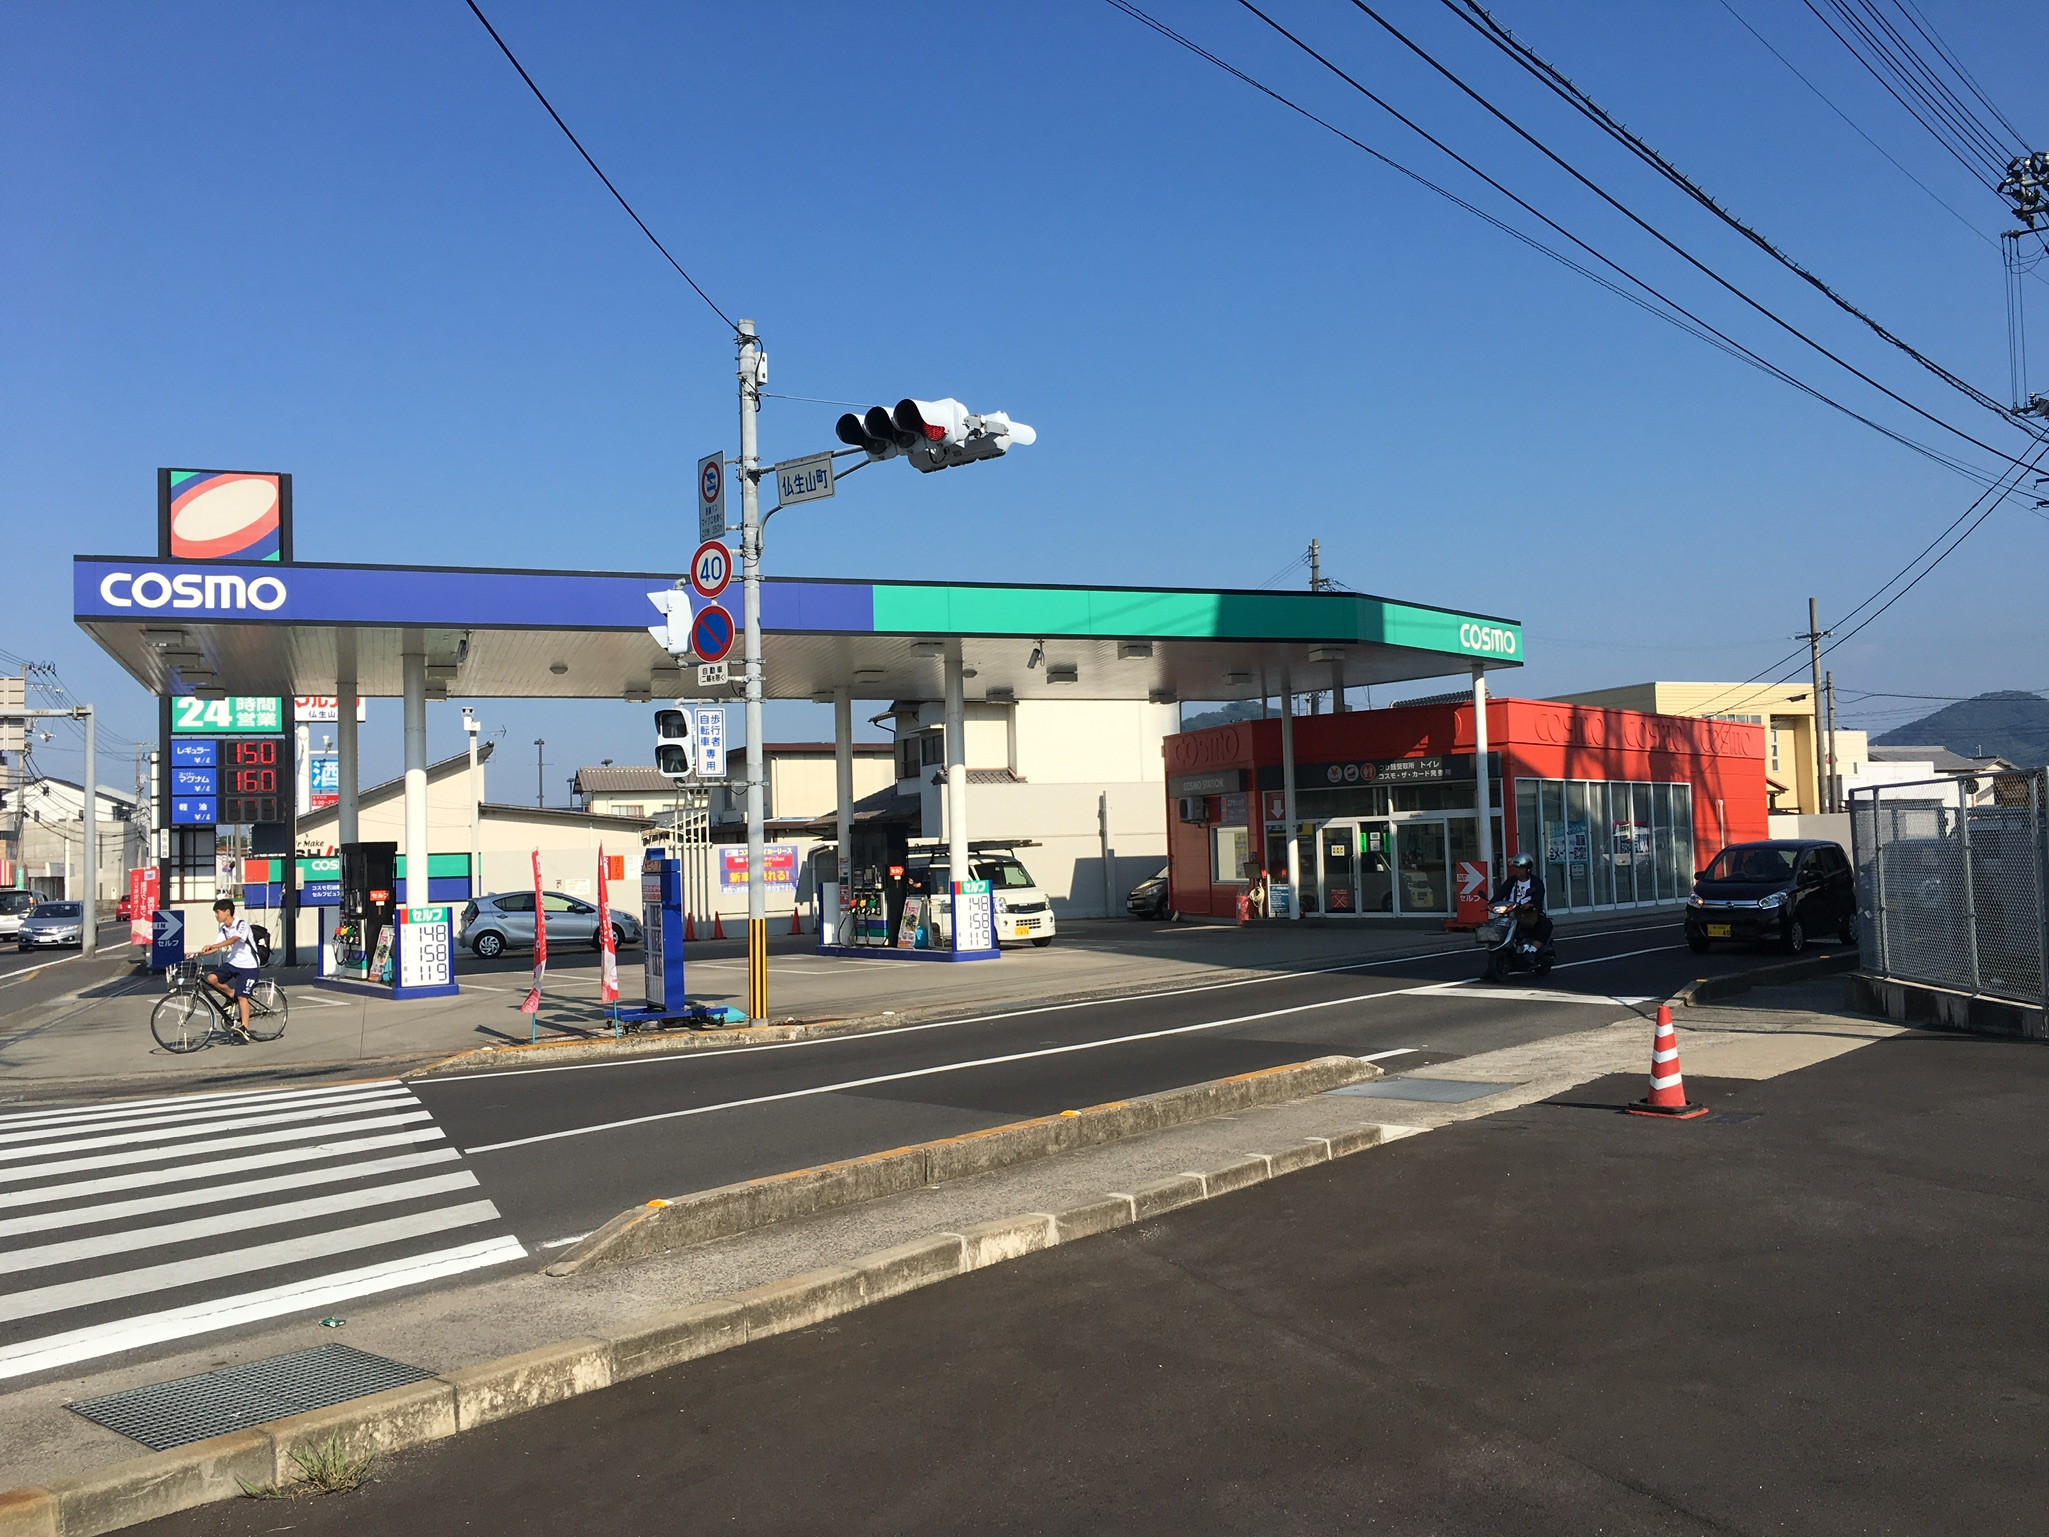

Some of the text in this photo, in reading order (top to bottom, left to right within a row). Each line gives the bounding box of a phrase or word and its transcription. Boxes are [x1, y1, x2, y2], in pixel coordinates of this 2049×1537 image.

[782, 469, 828, 497] 仏生山町
[700, 556, 724, 582] 40
[101, 572, 287, 611] COSMO
[1460, 623, 1516, 654] COSMO
[701, 673, 724, 683] 二輪を除く
[702, 665, 723, 675] 自動車
[177, 697, 232, 727] 24
[236, 698, 276, 712] 時間
[236, 713, 276, 727] 営業
[309, 710, 338, 719] 仏生山
[700, 715, 710, 746] 自転車
[711, 714, 720, 746] 歩行者
[177, 747, 211, 755] レギュラー
[236, 742, 275, 764] 150
[1176, 727, 1240, 766] COSMO
[706, 749, 716, 771] 専用
[1420, 760, 1440, 769] トイレ
[236, 770, 275, 793] 160
[313, 760, 339, 788] 酒
[1184, 778, 1225, 791] COSMO STATION
[303, 840, 325, 848] Make
[312, 860, 340, 871] COS
[371, 892, 389, 900] セルフ
[963, 883, 987, 895] セルフ
[969, 896, 989, 911] 148
[412, 910, 443, 922] セルフ
[969, 913, 990, 930] 158
[419, 924, 447, 942] 148
[970, 930, 991, 946] 119
[157, 940, 179, 948] セルフ
[419, 943, 448, 962] 158
[420, 963, 448, 981] 119
